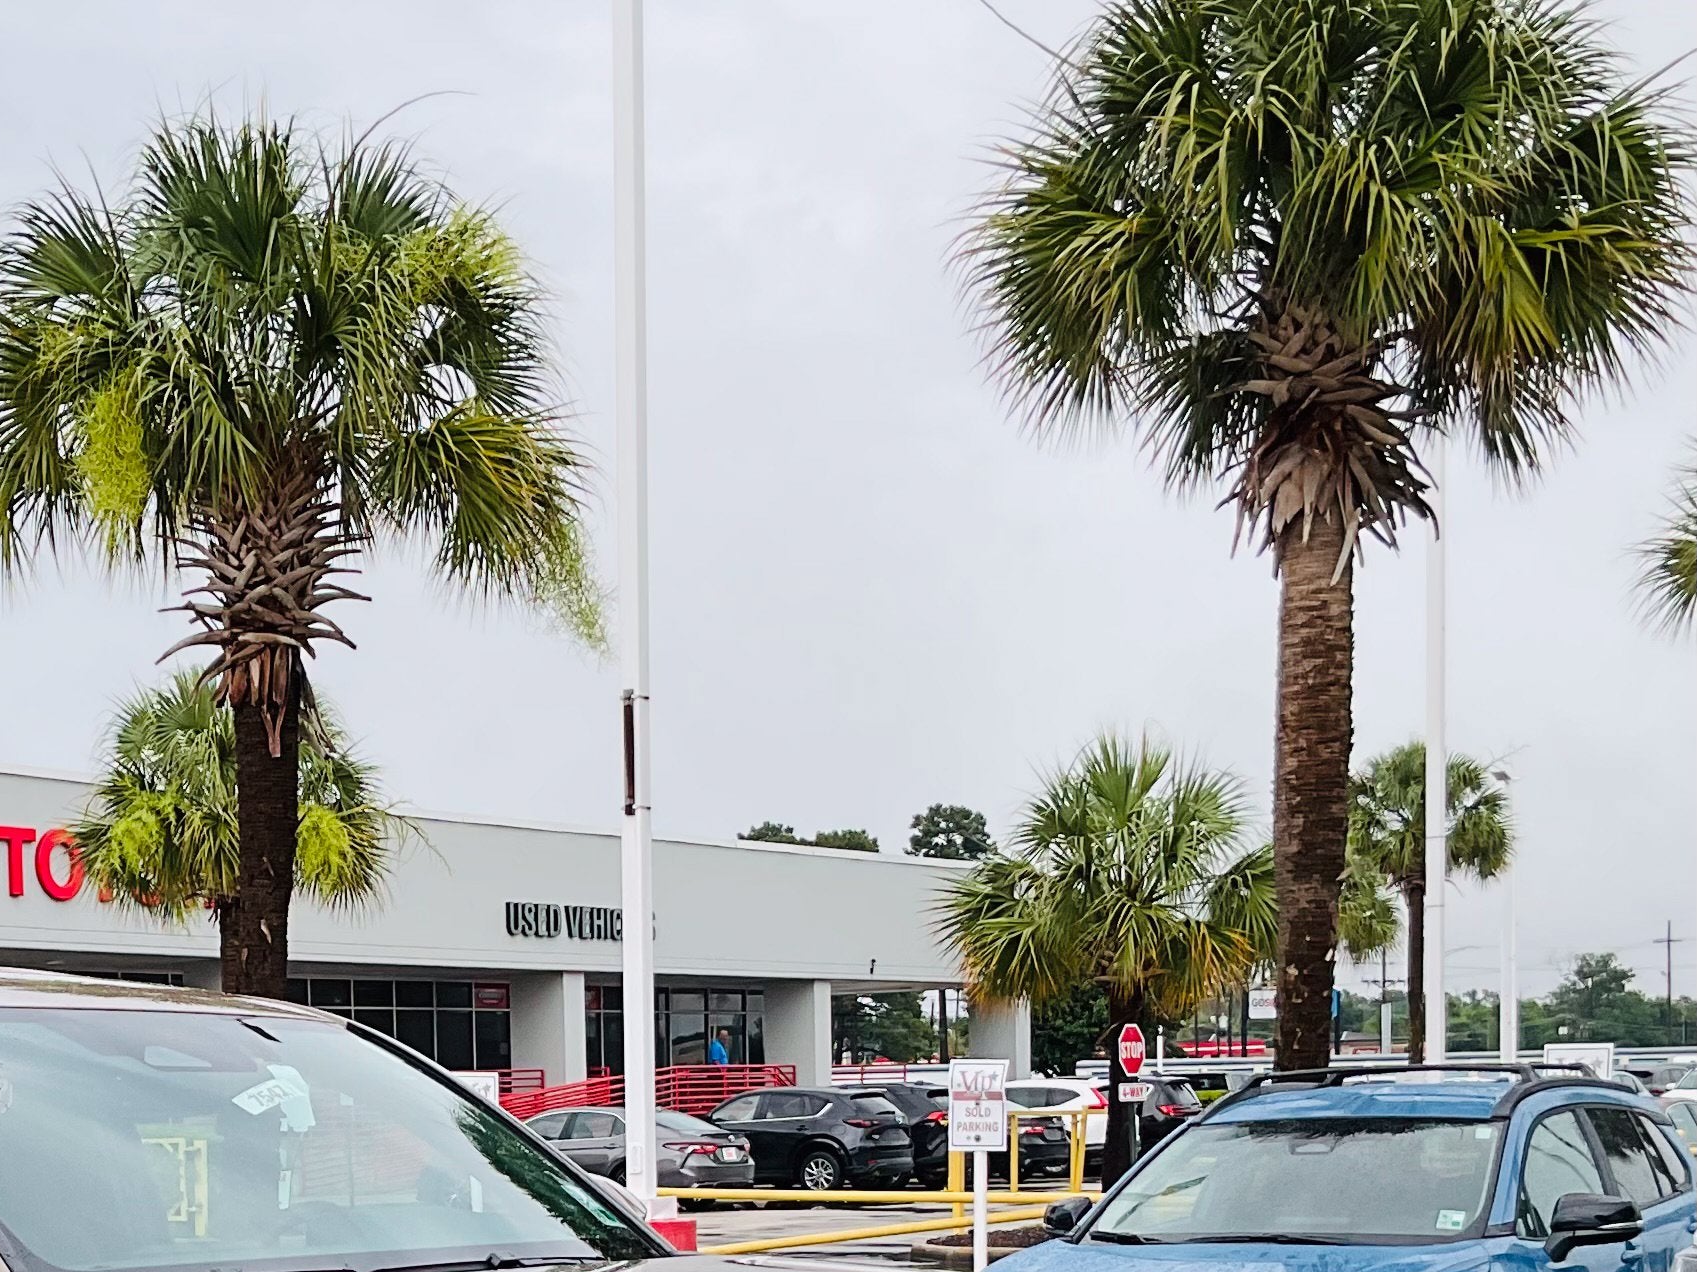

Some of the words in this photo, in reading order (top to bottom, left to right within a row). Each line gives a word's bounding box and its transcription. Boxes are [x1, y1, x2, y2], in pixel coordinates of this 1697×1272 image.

[505, 901, 562, 938] USED
[563, 905, 657, 942] VEHIC
[1120, 1041, 1143, 1059] STOP
[1122, 1086, 1144, 1098] 4-WAY
[965, 1106, 991, 1118] SOLD
[956, 1120, 999, 1133] PARKING
